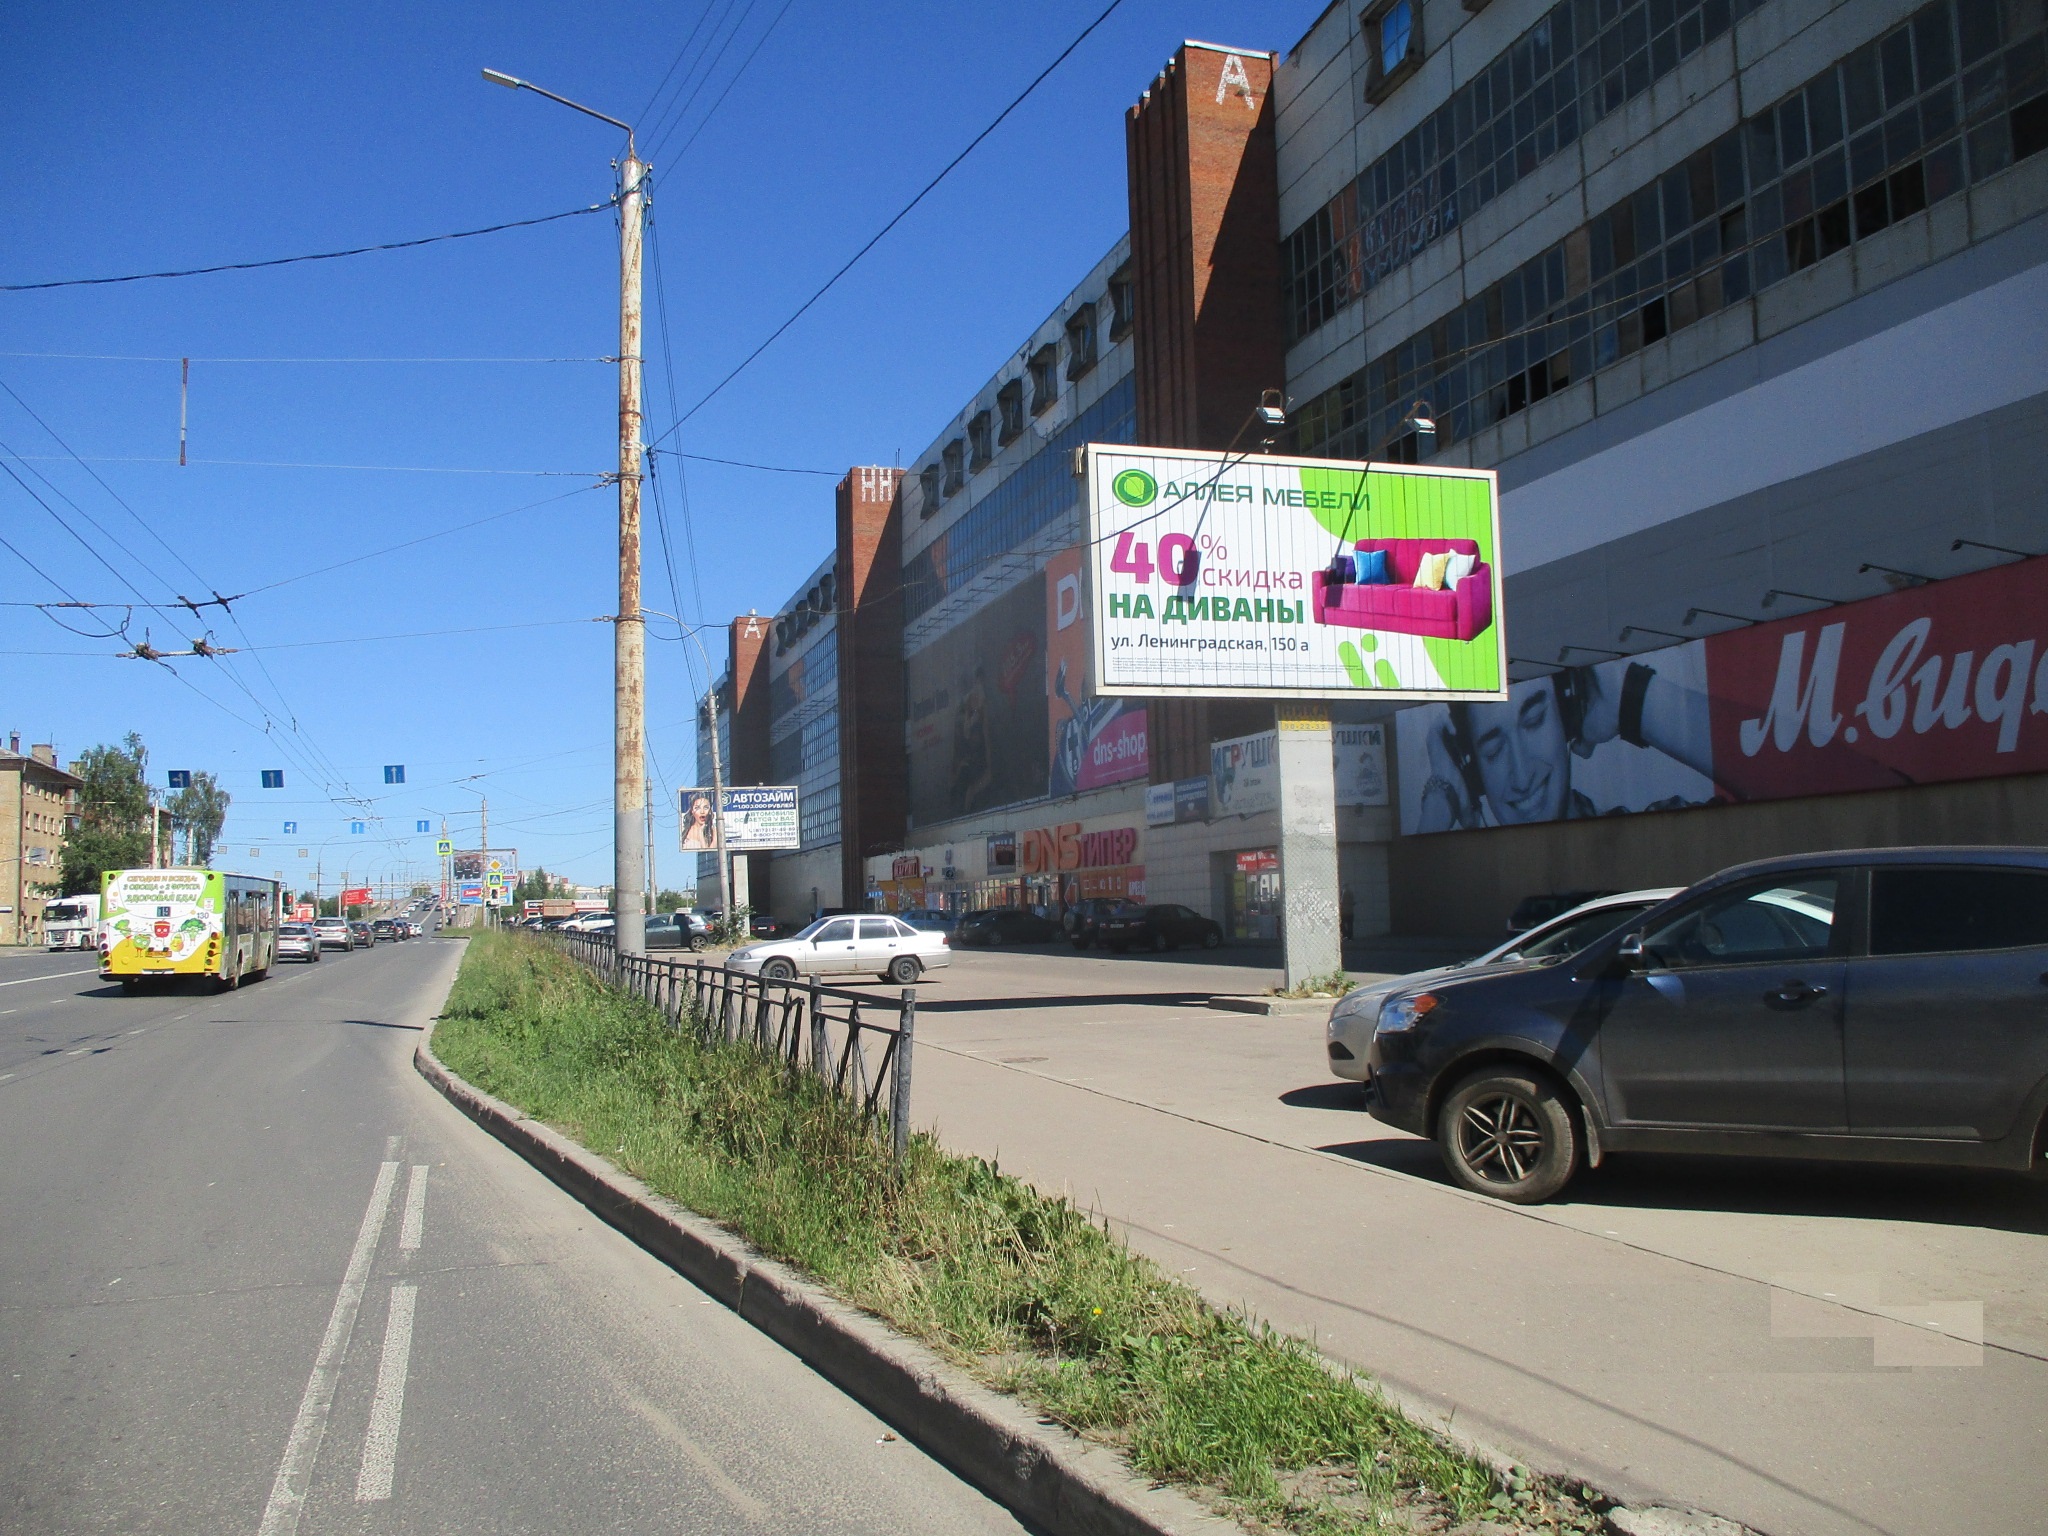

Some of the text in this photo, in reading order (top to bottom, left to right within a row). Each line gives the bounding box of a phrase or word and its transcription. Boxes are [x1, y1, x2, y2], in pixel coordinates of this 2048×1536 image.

[1163, 481, 1370, 511] АЛЛЕЯ МЕБЕЛИ
[1110, 532, 1198, 586] 40
[1203, 568, 1303, 593] скидка
[1056, 566, 1084, 632] D
[1109, 593, 1304, 625] НА ДИВАНЫ
[1111, 634, 1309, 652] ул. Ленинградская, 150 а
[1211, 735, 1278, 775] ИГРУШК
[732, 791, 793, 803] АВТОЗАЙМ
[1023, 822, 1081, 874] DNS
[1080, 827, 1137, 868] ГИПЕР
